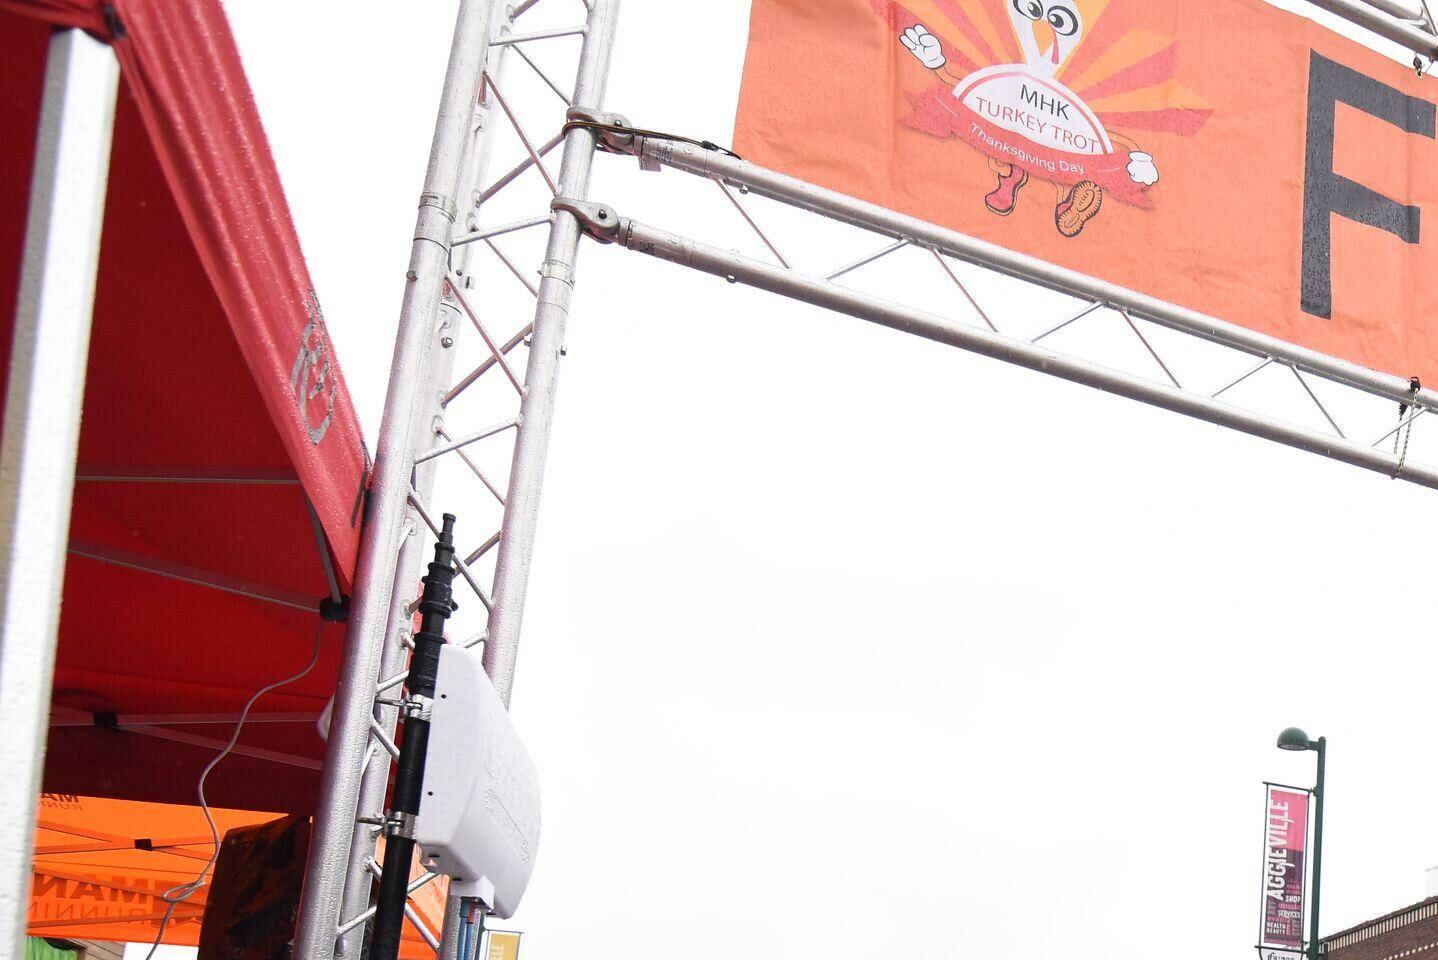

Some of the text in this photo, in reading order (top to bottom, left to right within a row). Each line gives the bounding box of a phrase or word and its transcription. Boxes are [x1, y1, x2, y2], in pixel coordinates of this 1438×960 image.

[976, 97, 1099, 153] TURKEY TROT
[1020, 84, 1069, 121] MHK
[971, 123, 1084, 175] Thanksgiving Day
[1267, 799, 1295, 901] AGGIEVILLE
